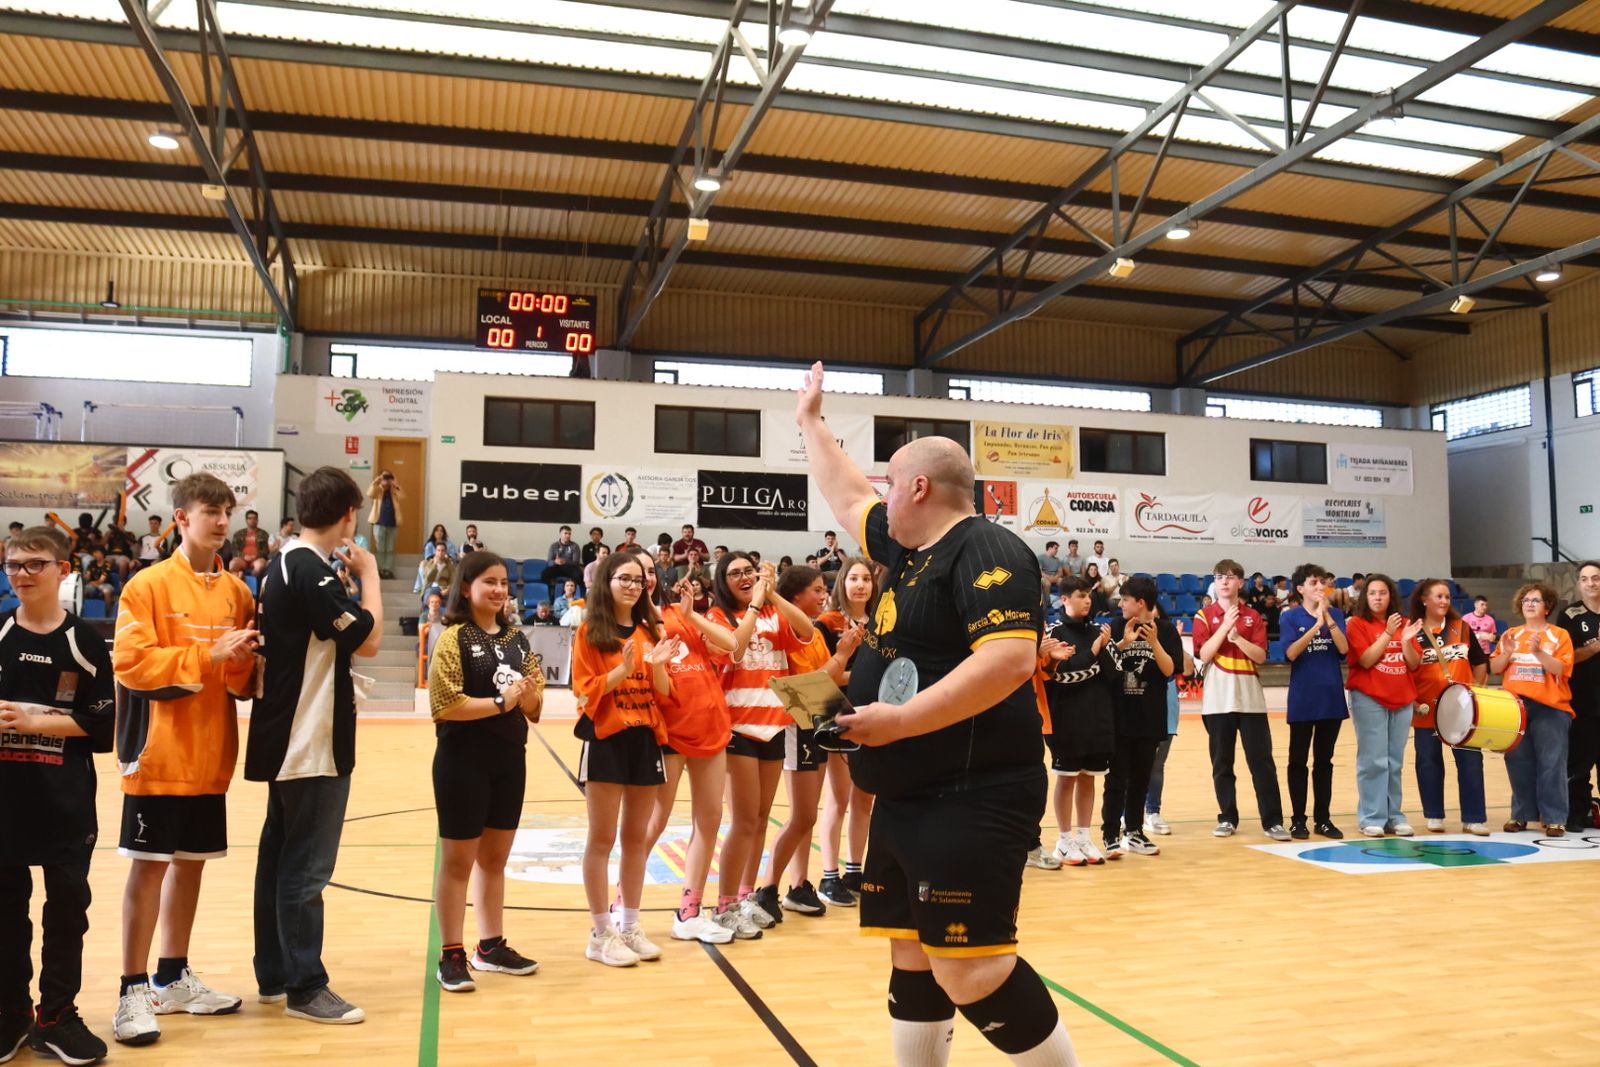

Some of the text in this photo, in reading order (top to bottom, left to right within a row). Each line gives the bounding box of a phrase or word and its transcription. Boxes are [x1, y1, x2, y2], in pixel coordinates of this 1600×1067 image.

[509, 292, 567, 313] 00:00
[480, 314, 512, 325] LOCAL
[559, 319, 590, 329] VISITANTE
[487, 328, 515, 347] 00
[566, 333, 592, 352] 00
[389, 395, 418, 404] DIGITAL
[985, 426, 1062, 441] La Flor de Iris
[461, 483, 580, 501] Pubeer
[1067, 491, 1117, 500] AUTOESCUELA
[1070, 499, 1115, 513] CODASA
[1325, 499, 1361, 507] RECICLAJES
[1145, 512, 1208, 523] TARDAGUILA
[1325, 510, 1360, 518] MONTALVO
[1581, 621, 1589, 632] 6
[1436, 636, 1444, 647] 6
[494, 644, 504, 660] 6
